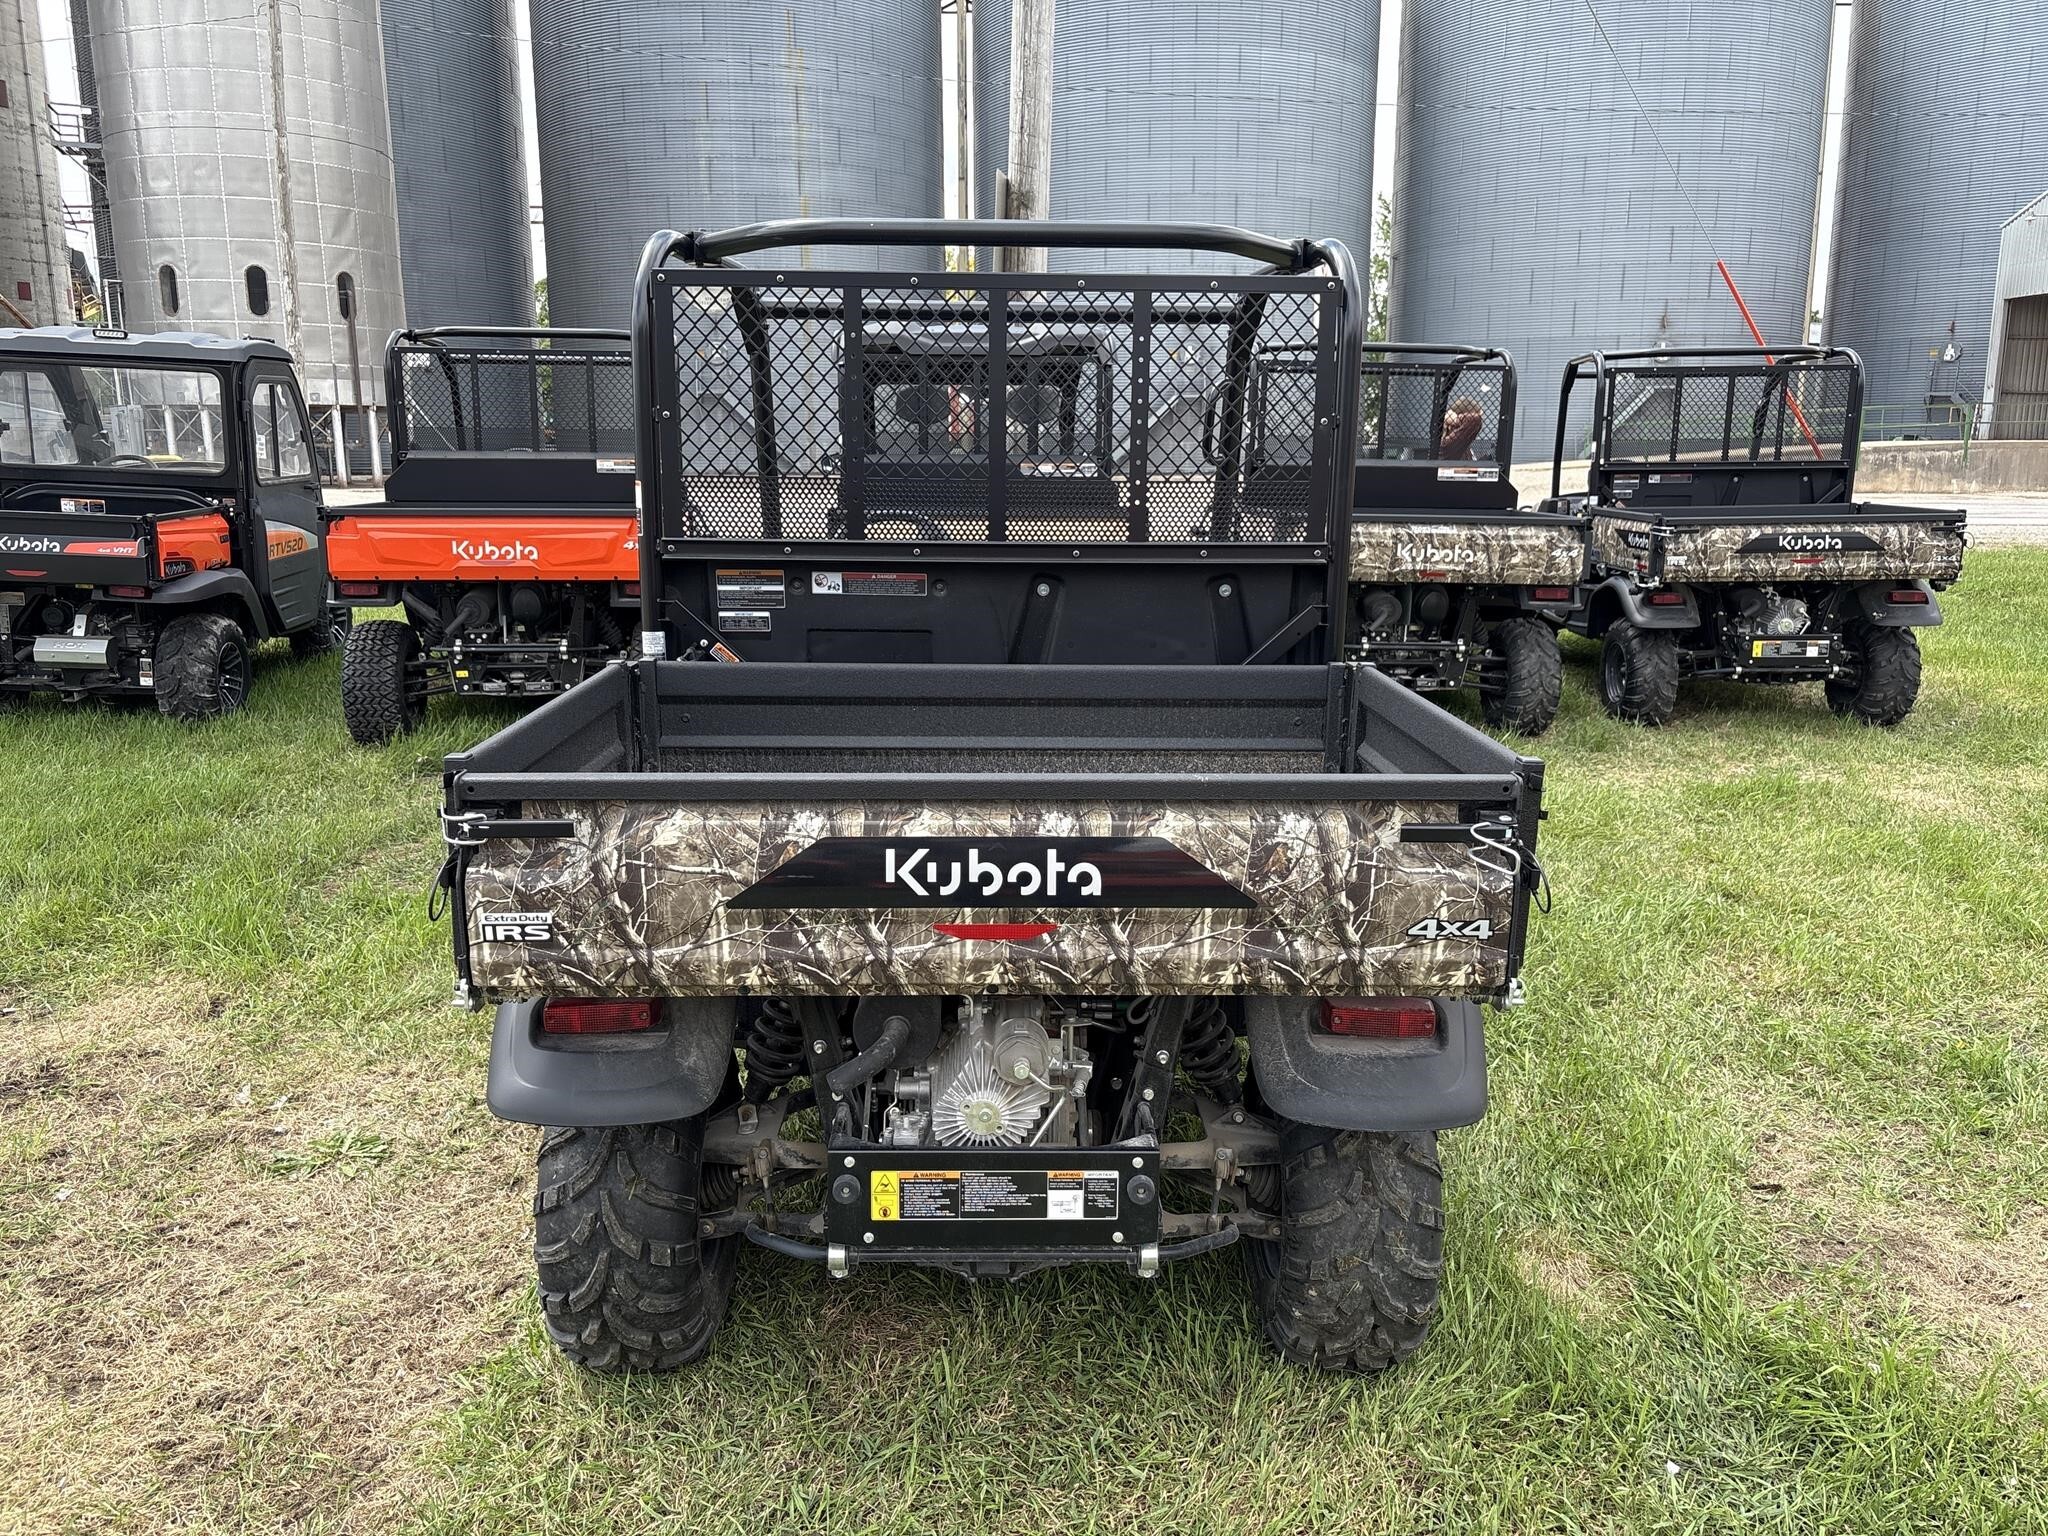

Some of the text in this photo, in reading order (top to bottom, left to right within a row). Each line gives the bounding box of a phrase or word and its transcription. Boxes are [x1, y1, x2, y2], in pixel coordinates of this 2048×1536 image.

[0, 536, 61, 553] Kubota
[269, 537, 304, 557] RTV520
[1628, 532, 1649, 549] Kubota
[1778, 534, 1842, 550] Kubota
[452, 540, 539, 560] Kubota
[1397, 543, 1474, 563] Kubota
[1551, 548, 1579, 558] 4x4
[1932, 554, 1957, 562] 4x4
[166, 562, 186, 577] Kubota
[885, 848, 1102, 896] Kubota
[484, 914, 548, 922] Extra Duty
[484, 925, 551, 941] IRS
[1407, 918, 1493, 940] 4x4
